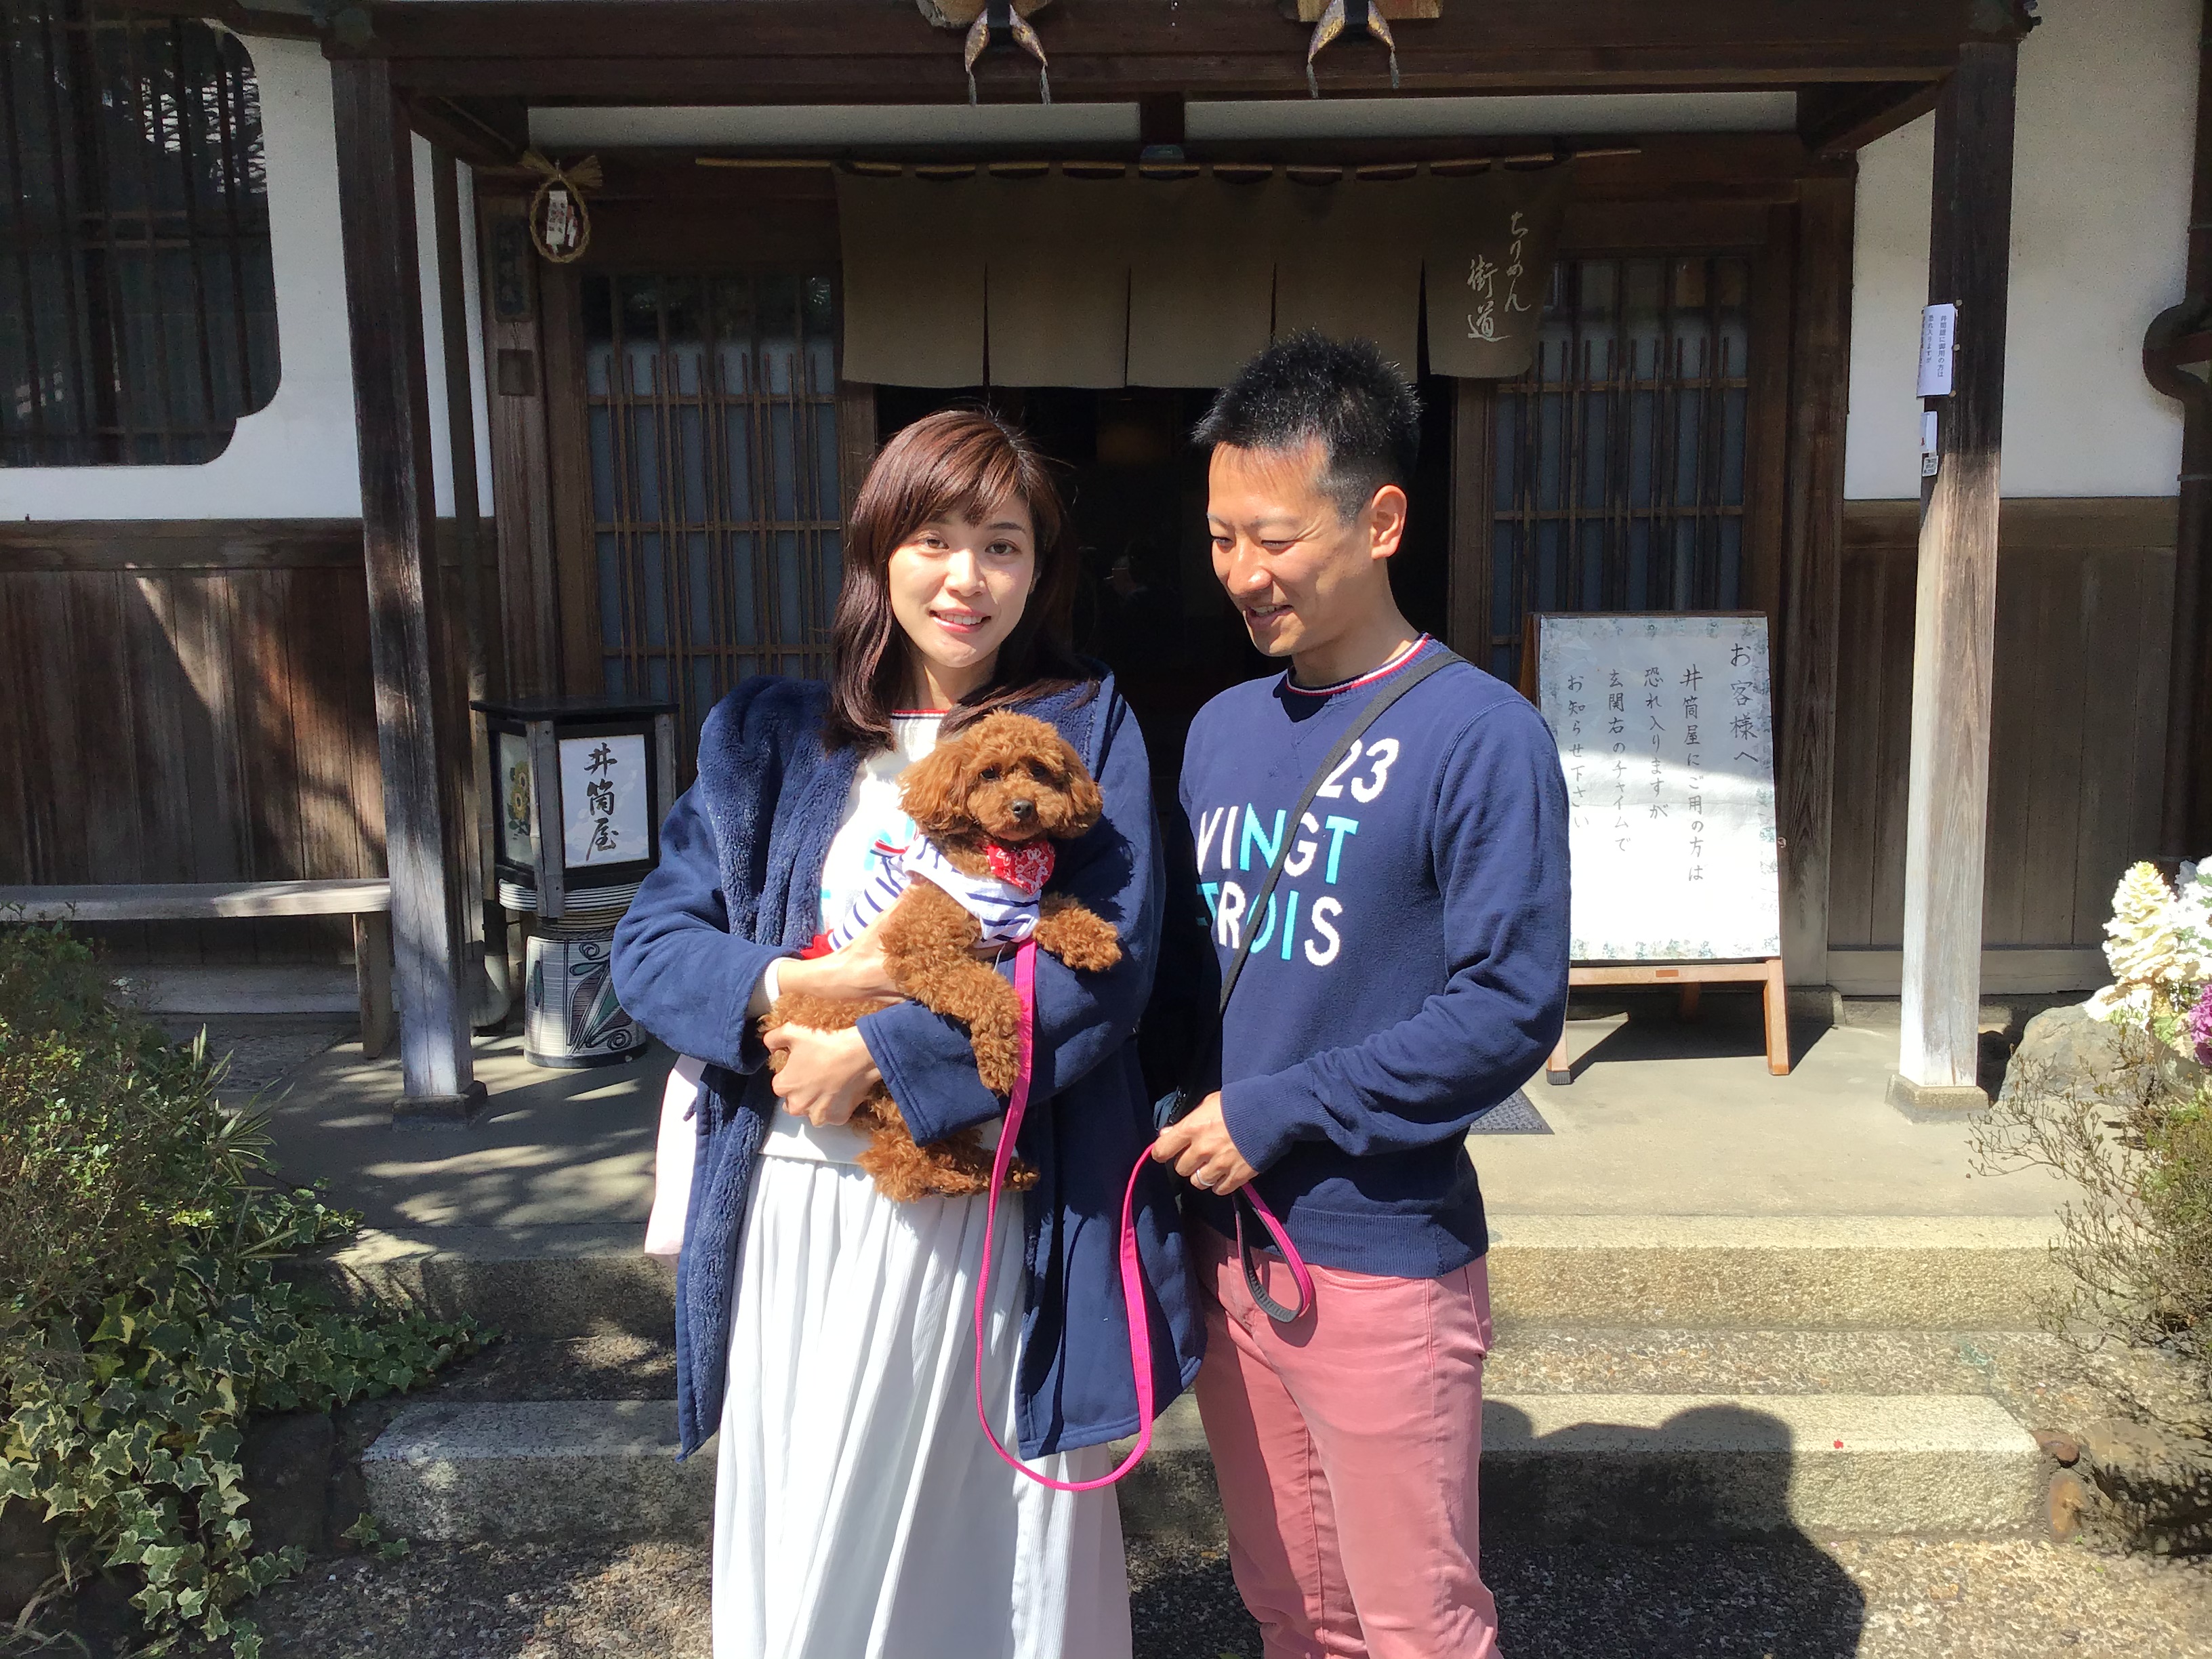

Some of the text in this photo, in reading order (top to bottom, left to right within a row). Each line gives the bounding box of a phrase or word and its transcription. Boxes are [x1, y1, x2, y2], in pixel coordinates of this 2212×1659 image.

[1467, 254, 1511, 342] 街道
[1568, 675, 1589, 828] お知らせ下さい
[1608, 668, 1631, 852] 玄関右のチャイムで
[1643, 667, 1668, 819] 恐れ入りますが
[1729, 642, 1759, 763] お客様へ
[583, 742, 619, 862] 井筒屋
[1315, 737, 1399, 803] 23
[1679, 663, 1704, 882] 井筒屋にご用の方は
[1197, 802, 1359, 885] VINGT
[1196, 881, 1343, 967] TROIS
